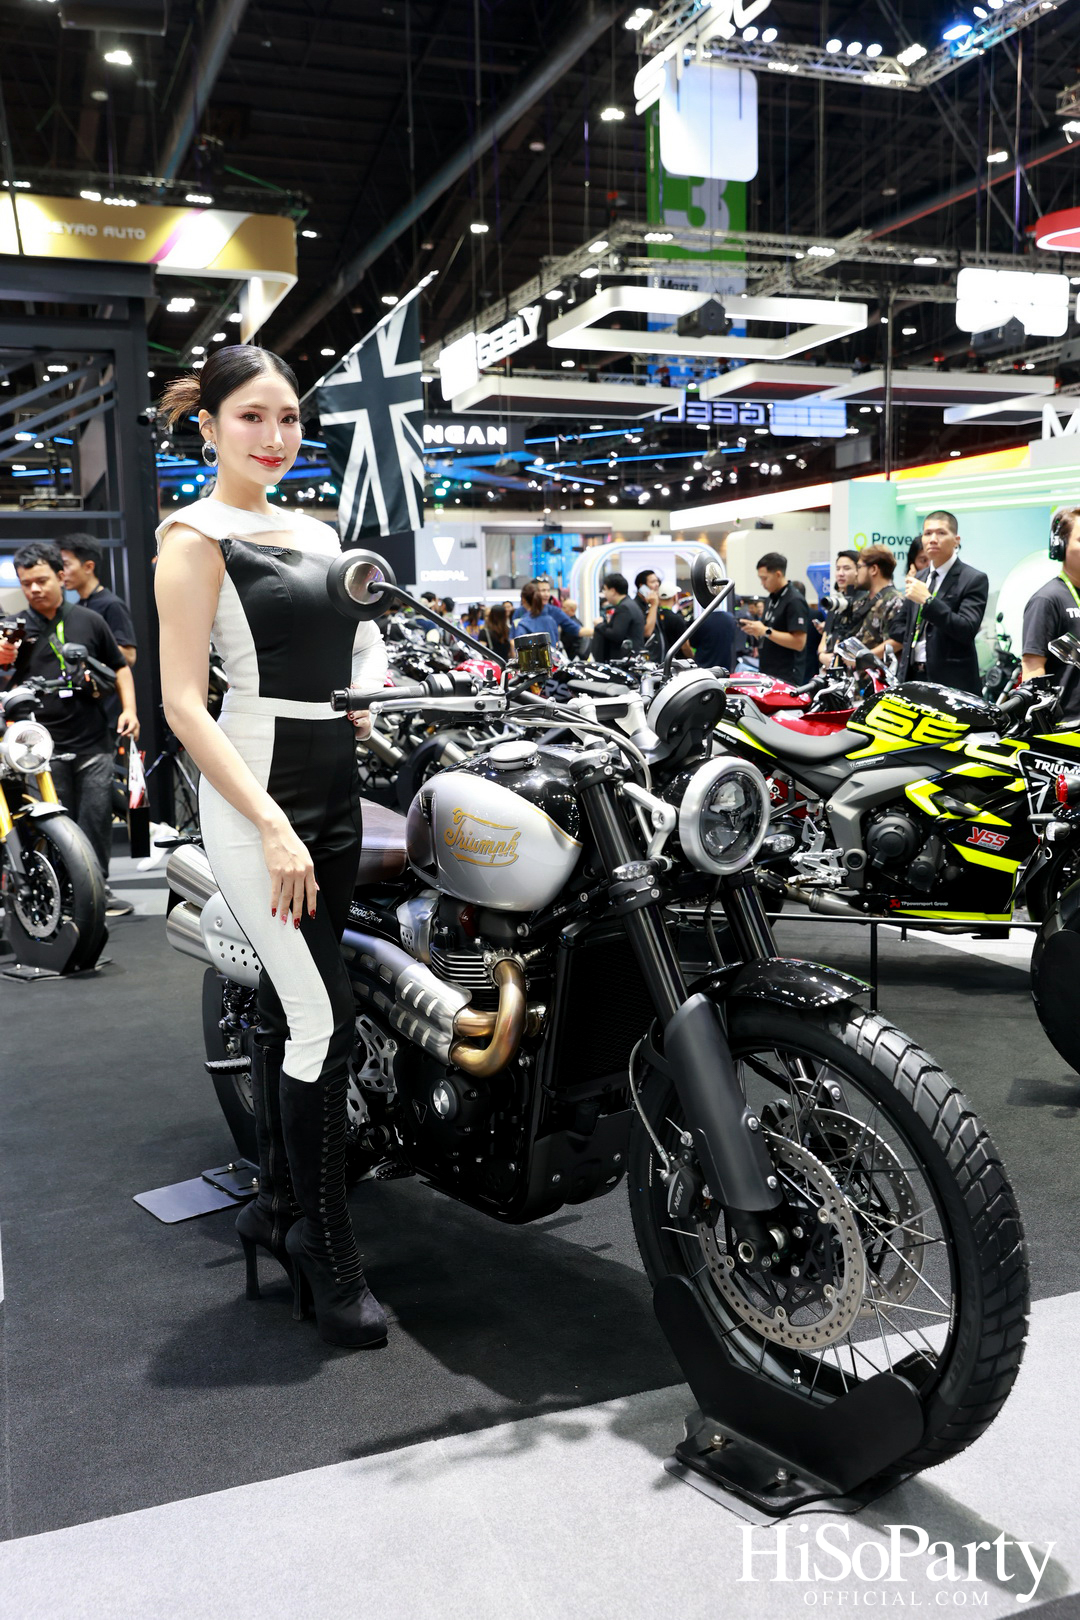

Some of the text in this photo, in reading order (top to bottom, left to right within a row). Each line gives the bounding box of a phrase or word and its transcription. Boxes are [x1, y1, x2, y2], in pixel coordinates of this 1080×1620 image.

[103, 225, 146, 240] AUTO
[475, 305, 543, 370] GEELY
[443, 807, 521, 867] Triumph
[966, 826, 1010, 848] YSS
